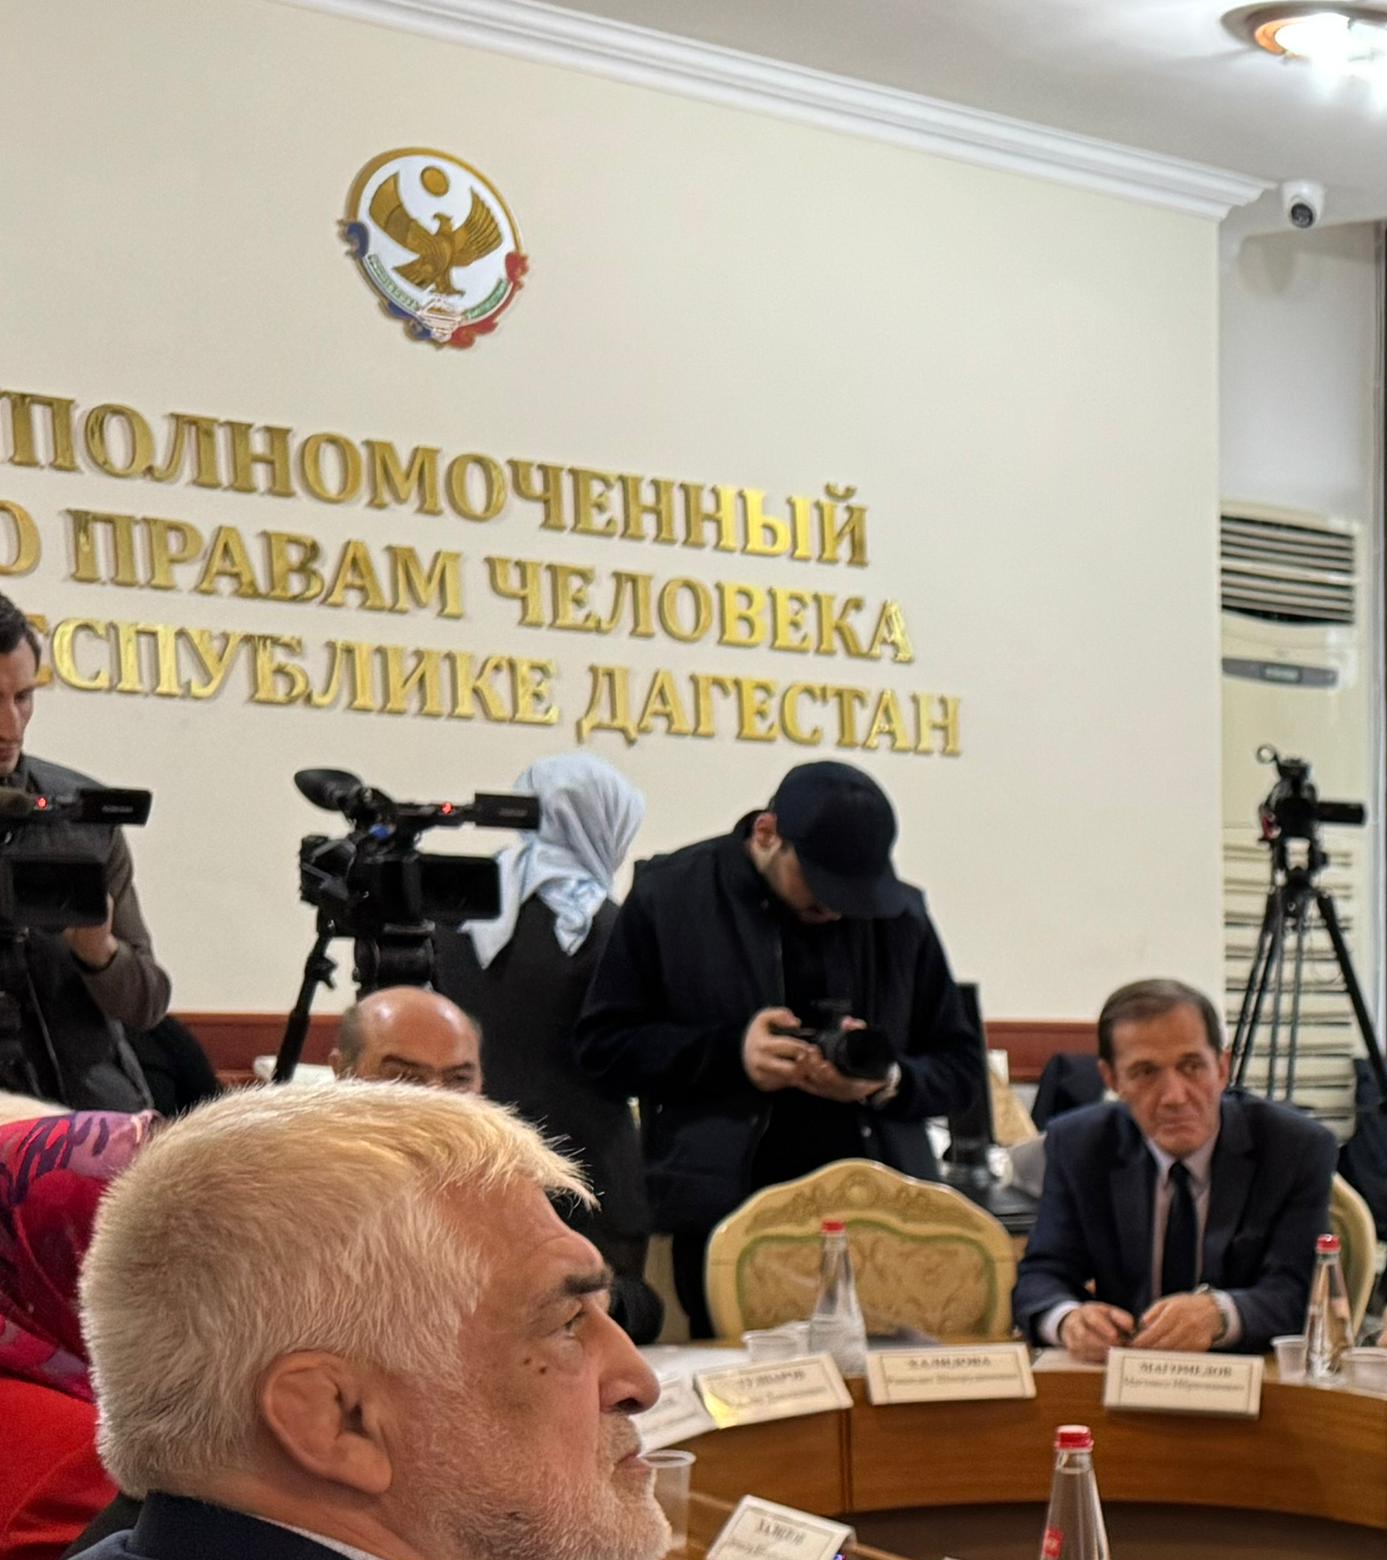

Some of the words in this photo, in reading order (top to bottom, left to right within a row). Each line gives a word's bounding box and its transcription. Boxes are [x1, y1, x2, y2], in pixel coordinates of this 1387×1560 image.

[0, 388, 869, 569] ПОЛНОМОЧЕННЫЙ
[65, 508, 465, 620] ПРАВАМ
[485, 557, 914, 664] ЧЕЛОВЕКА
[575, 662, 962, 757] ДАГЕСТАН
